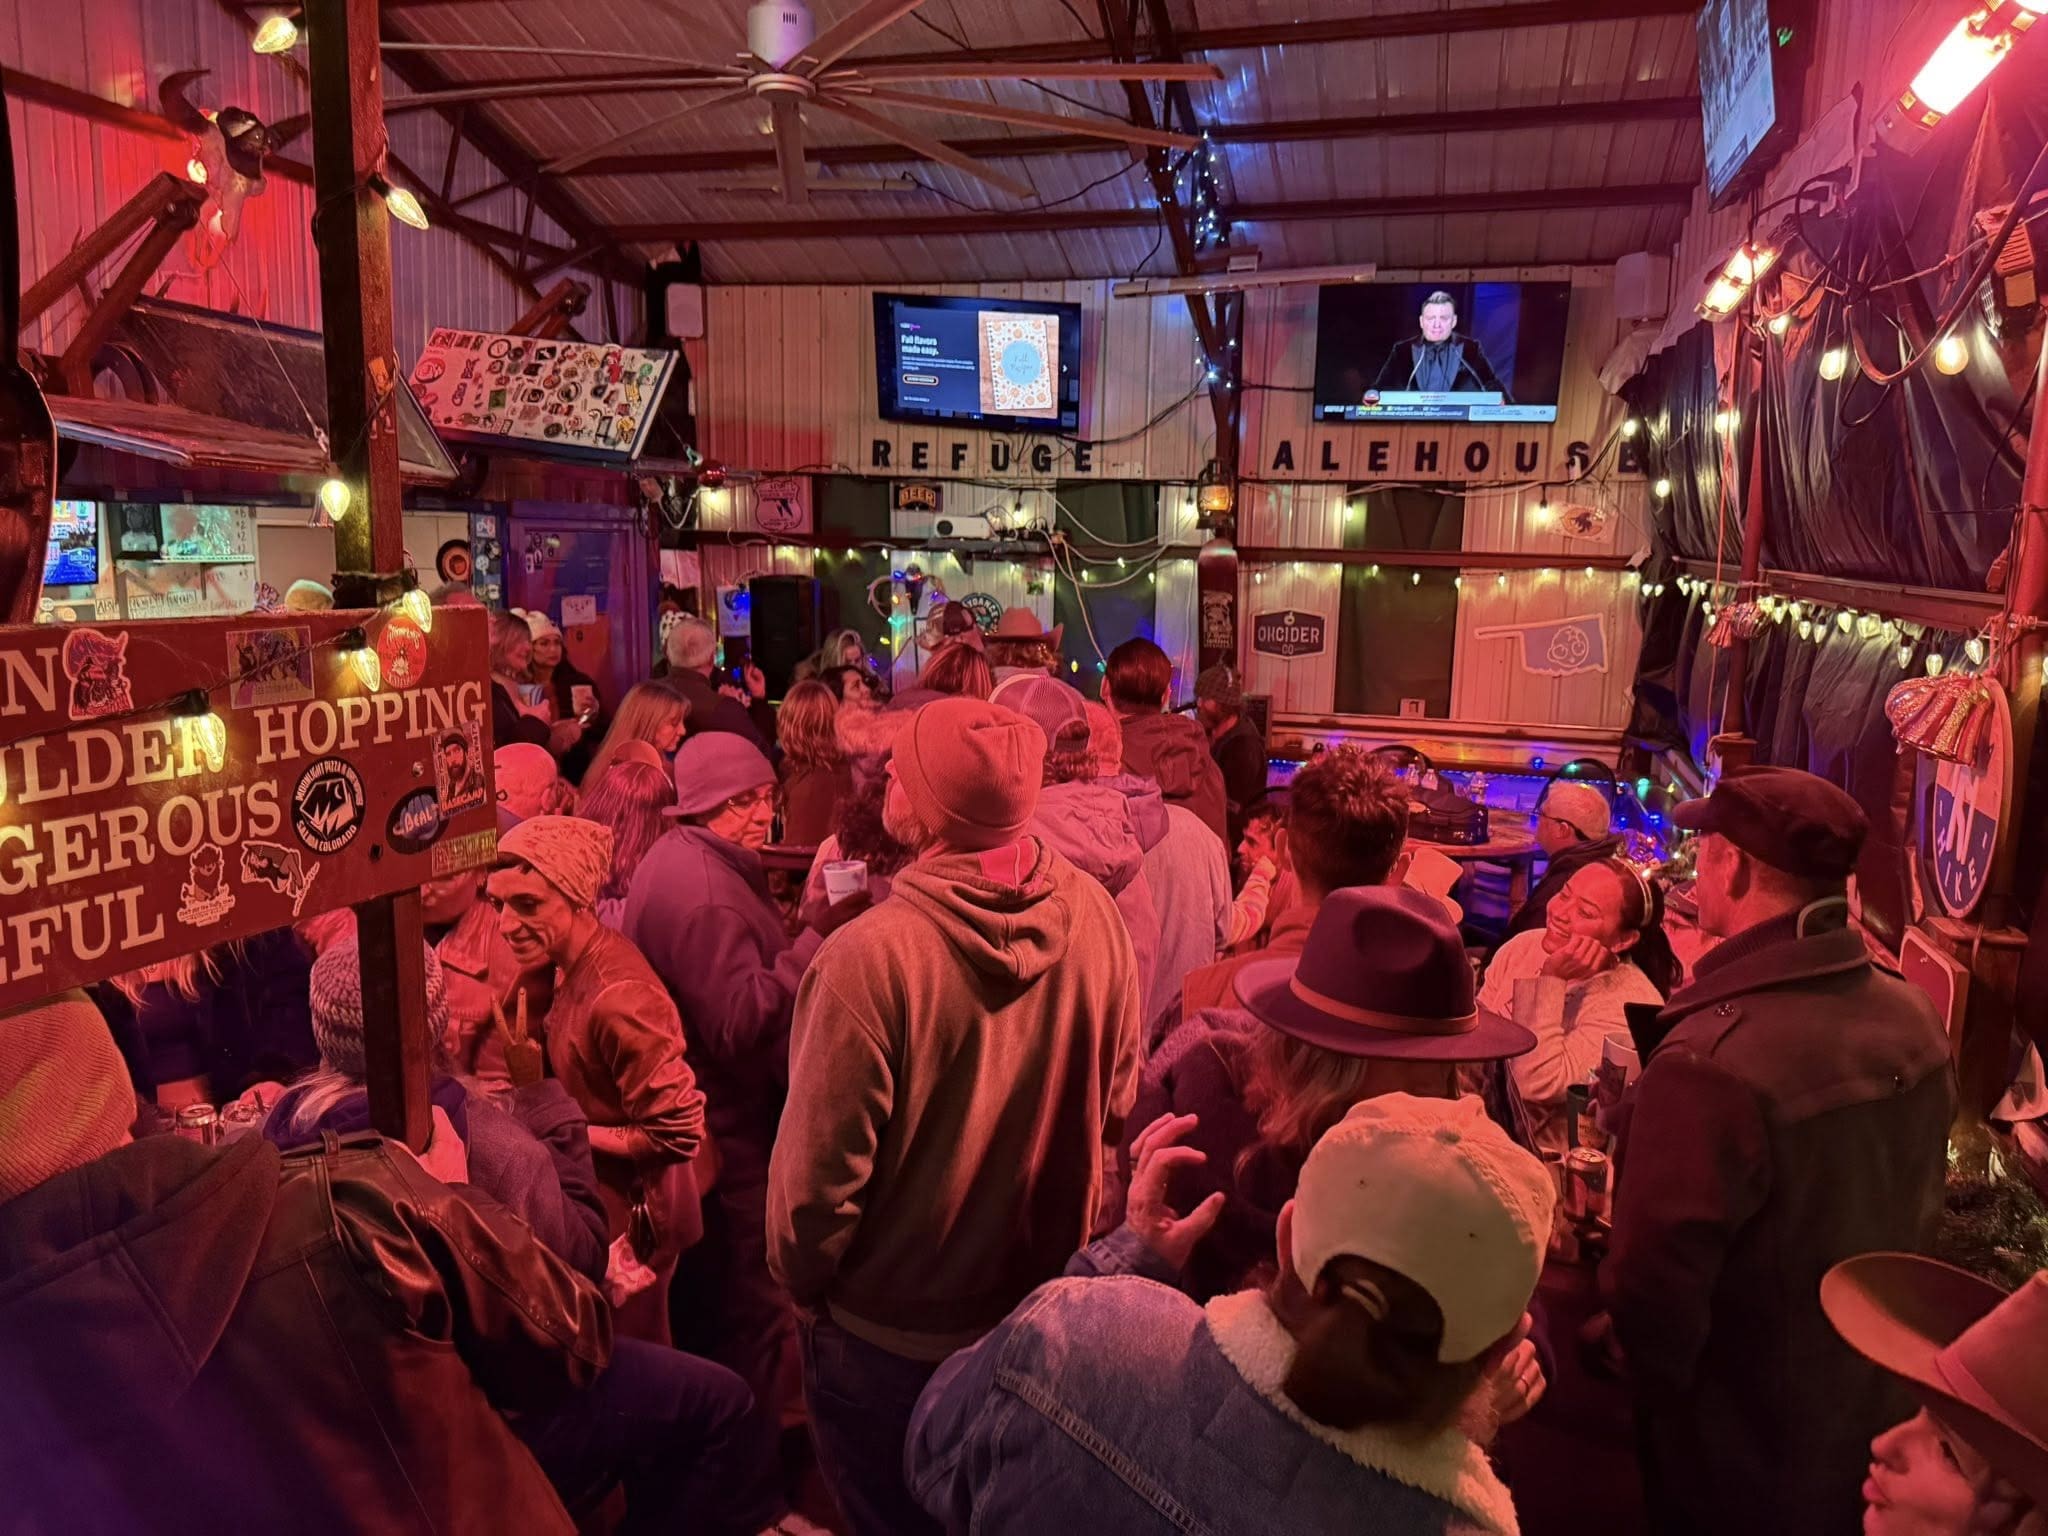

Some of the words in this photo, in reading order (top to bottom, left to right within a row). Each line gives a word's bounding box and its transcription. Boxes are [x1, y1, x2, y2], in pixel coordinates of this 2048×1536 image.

[872, 439, 1093, 472] REFUGE
[1272, 440, 1648, 474] ALEHOUSE
[900, 487, 936, 508] BEER
[1281, 643, 1295, 655] CO
[253, 680, 487, 765] HOPPING
[318, 833, 358, 853] COLORADO
[0, 885, 165, 984] FUL
